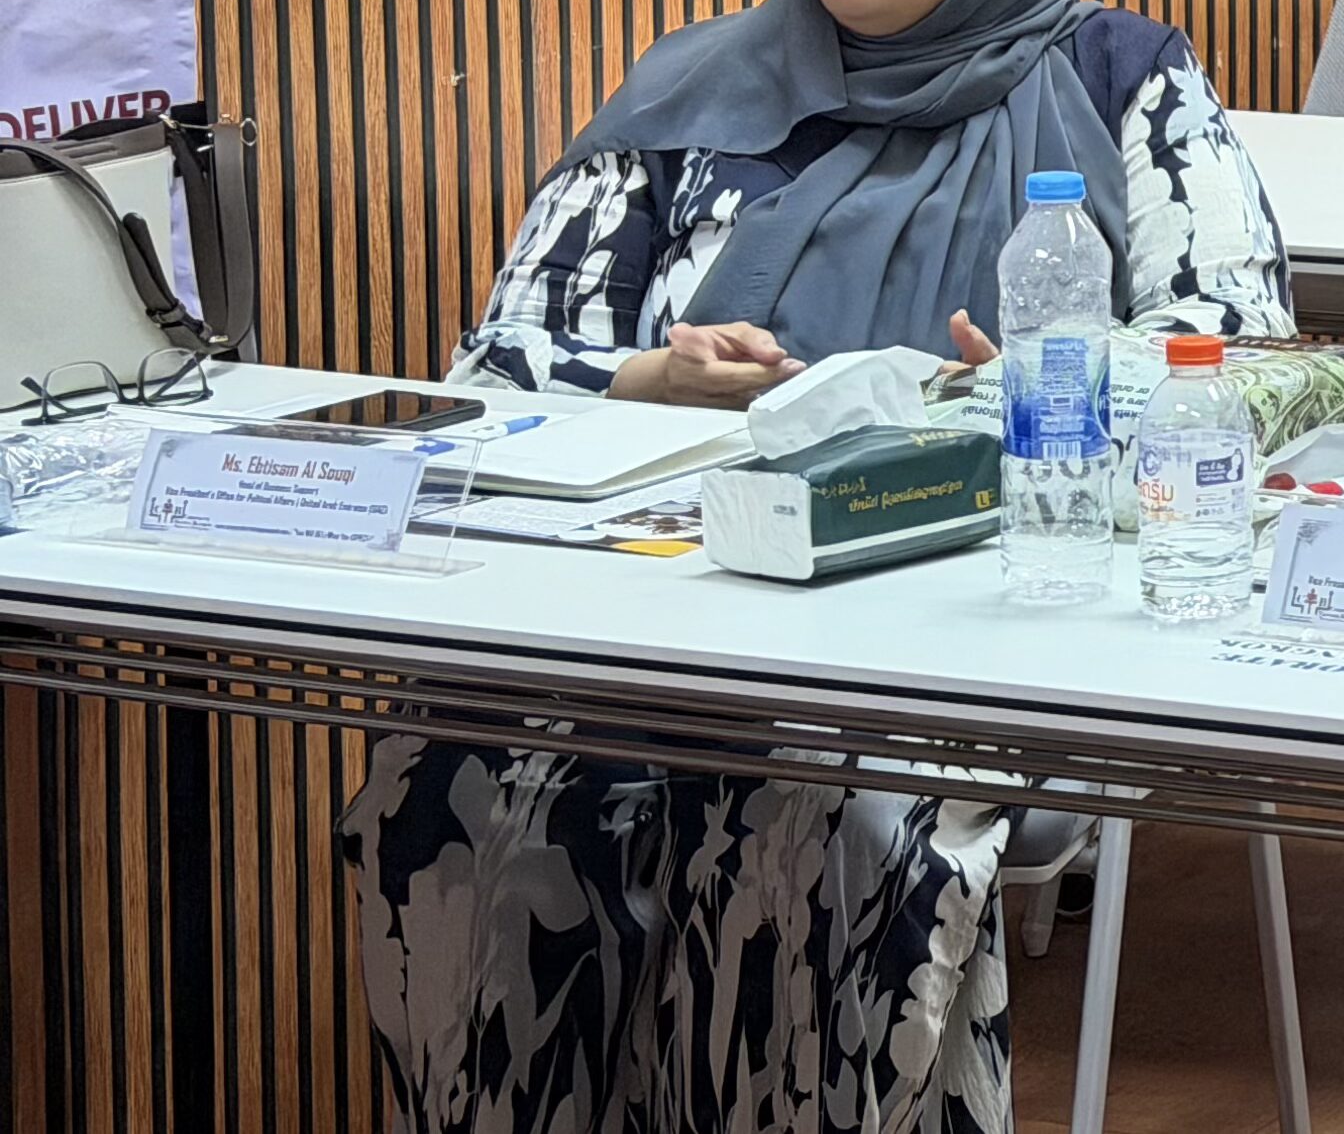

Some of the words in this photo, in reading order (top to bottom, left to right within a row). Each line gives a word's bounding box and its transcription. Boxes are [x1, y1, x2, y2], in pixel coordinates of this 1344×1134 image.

[222, 453, 243, 473] Ms.
[247, 455, 299, 477] Ebtisam
[302, 460, 317, 479] Al
